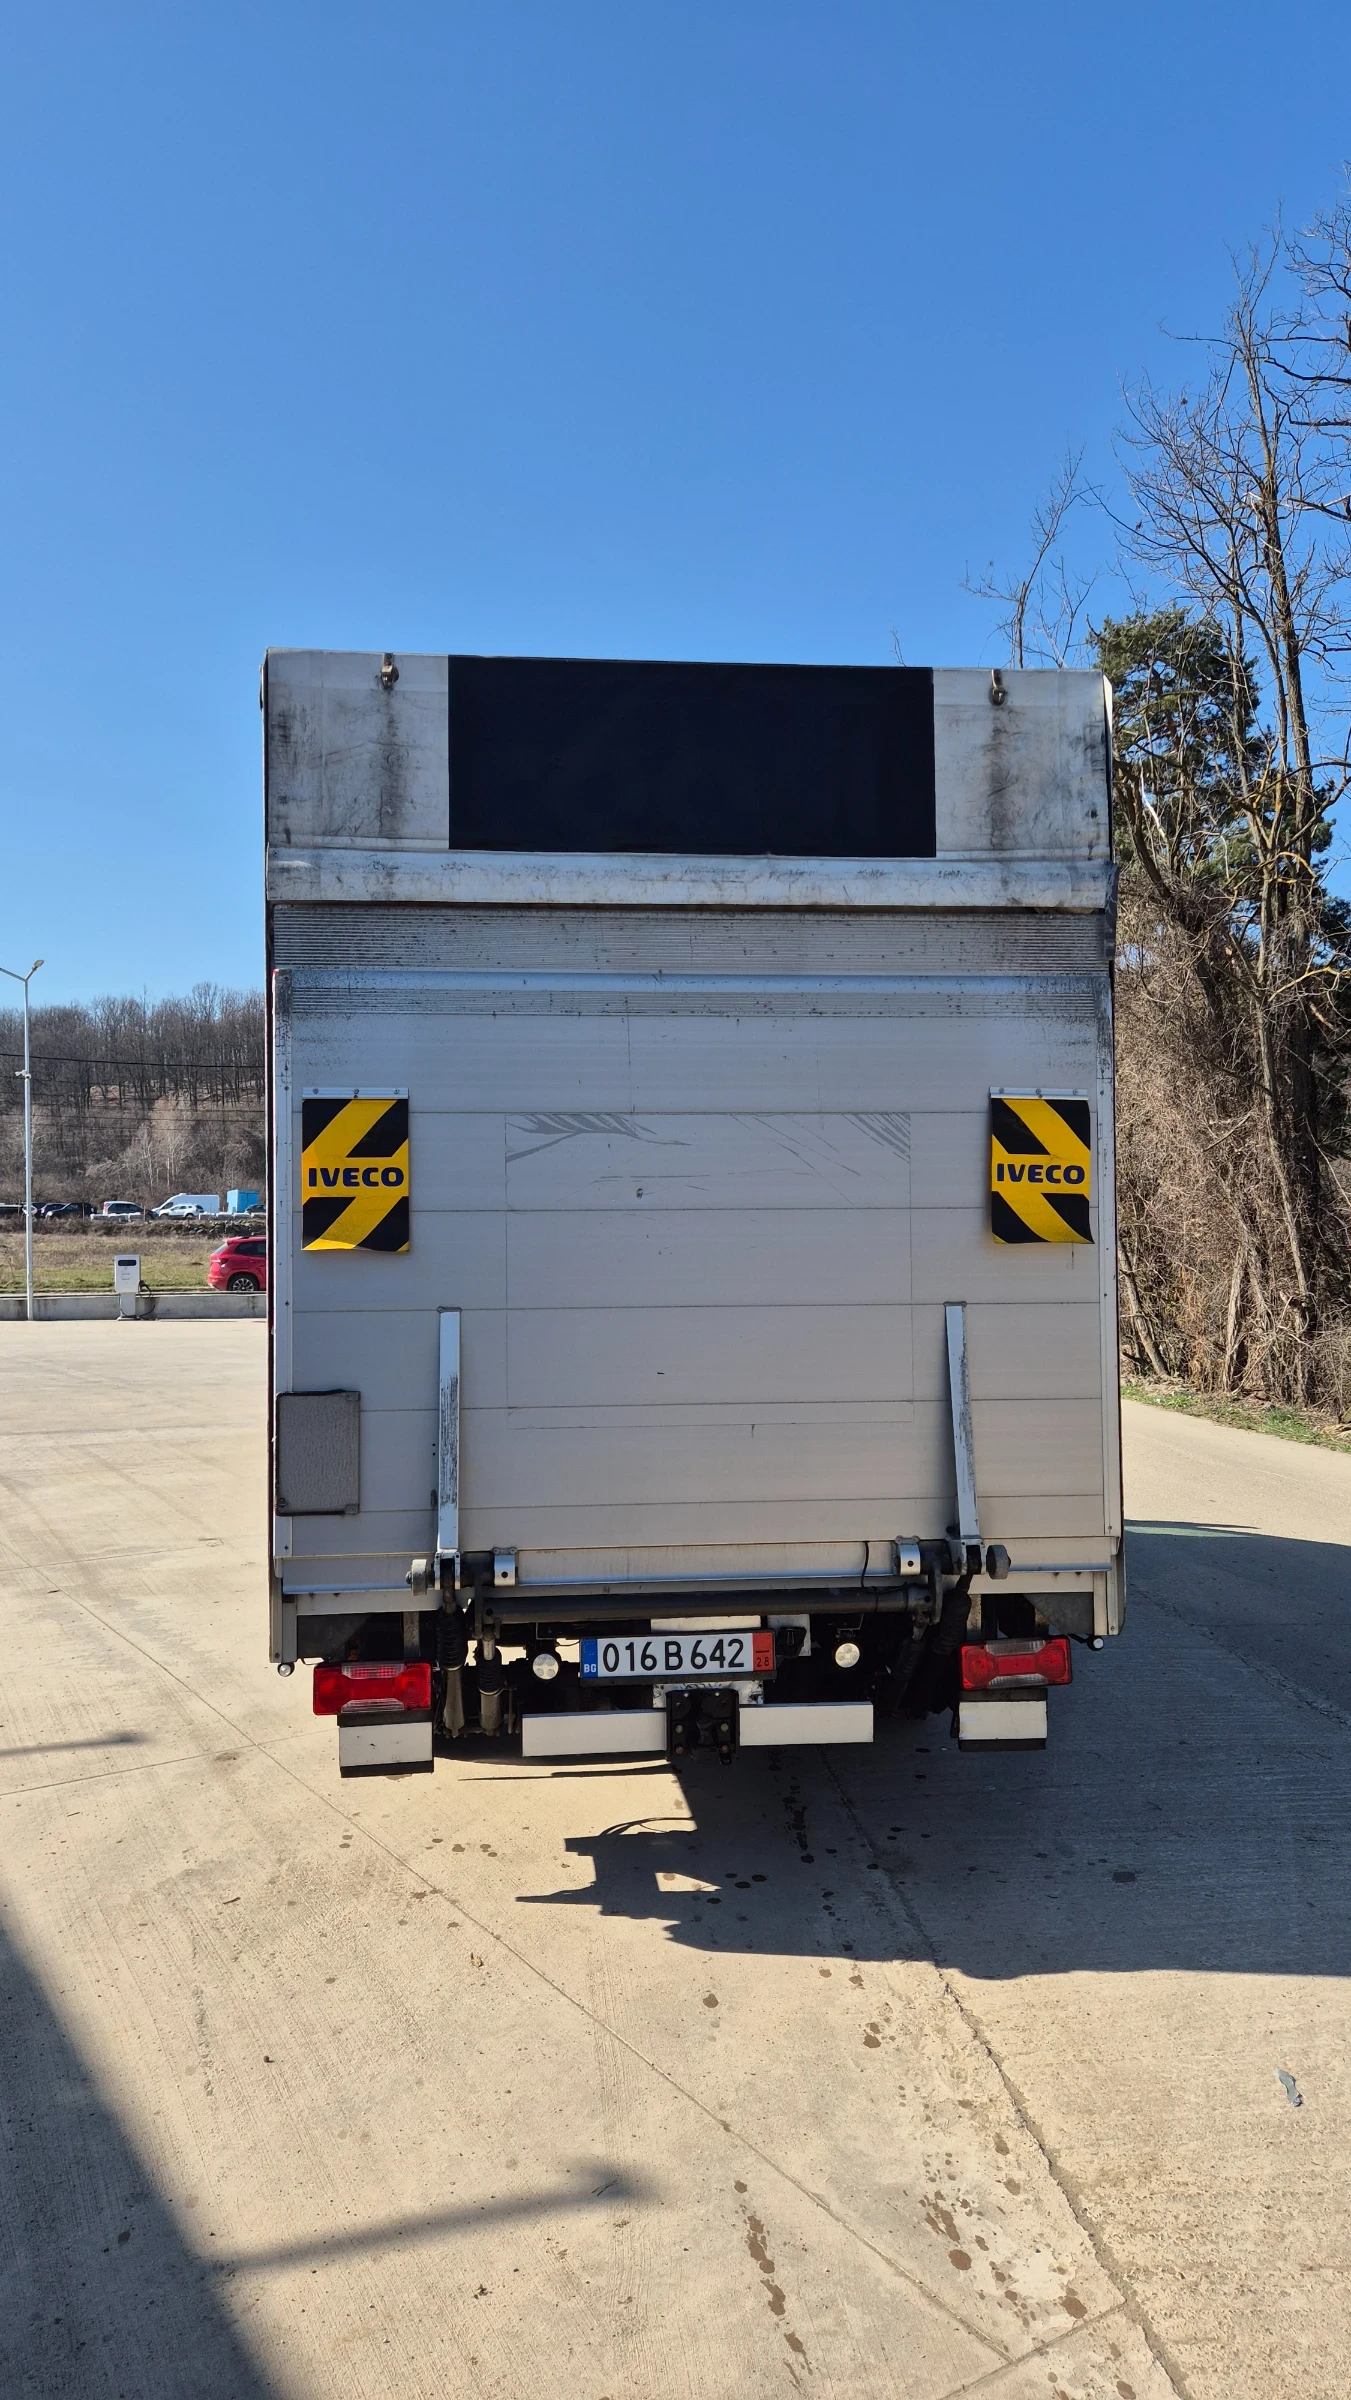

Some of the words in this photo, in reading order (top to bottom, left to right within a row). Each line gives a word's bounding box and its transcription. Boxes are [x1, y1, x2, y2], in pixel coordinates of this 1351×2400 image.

[309, 1167, 405, 1187] IVECO
[997, 1163, 1085, 1184] IVECO
[583, 1663, 597, 1673] BG
